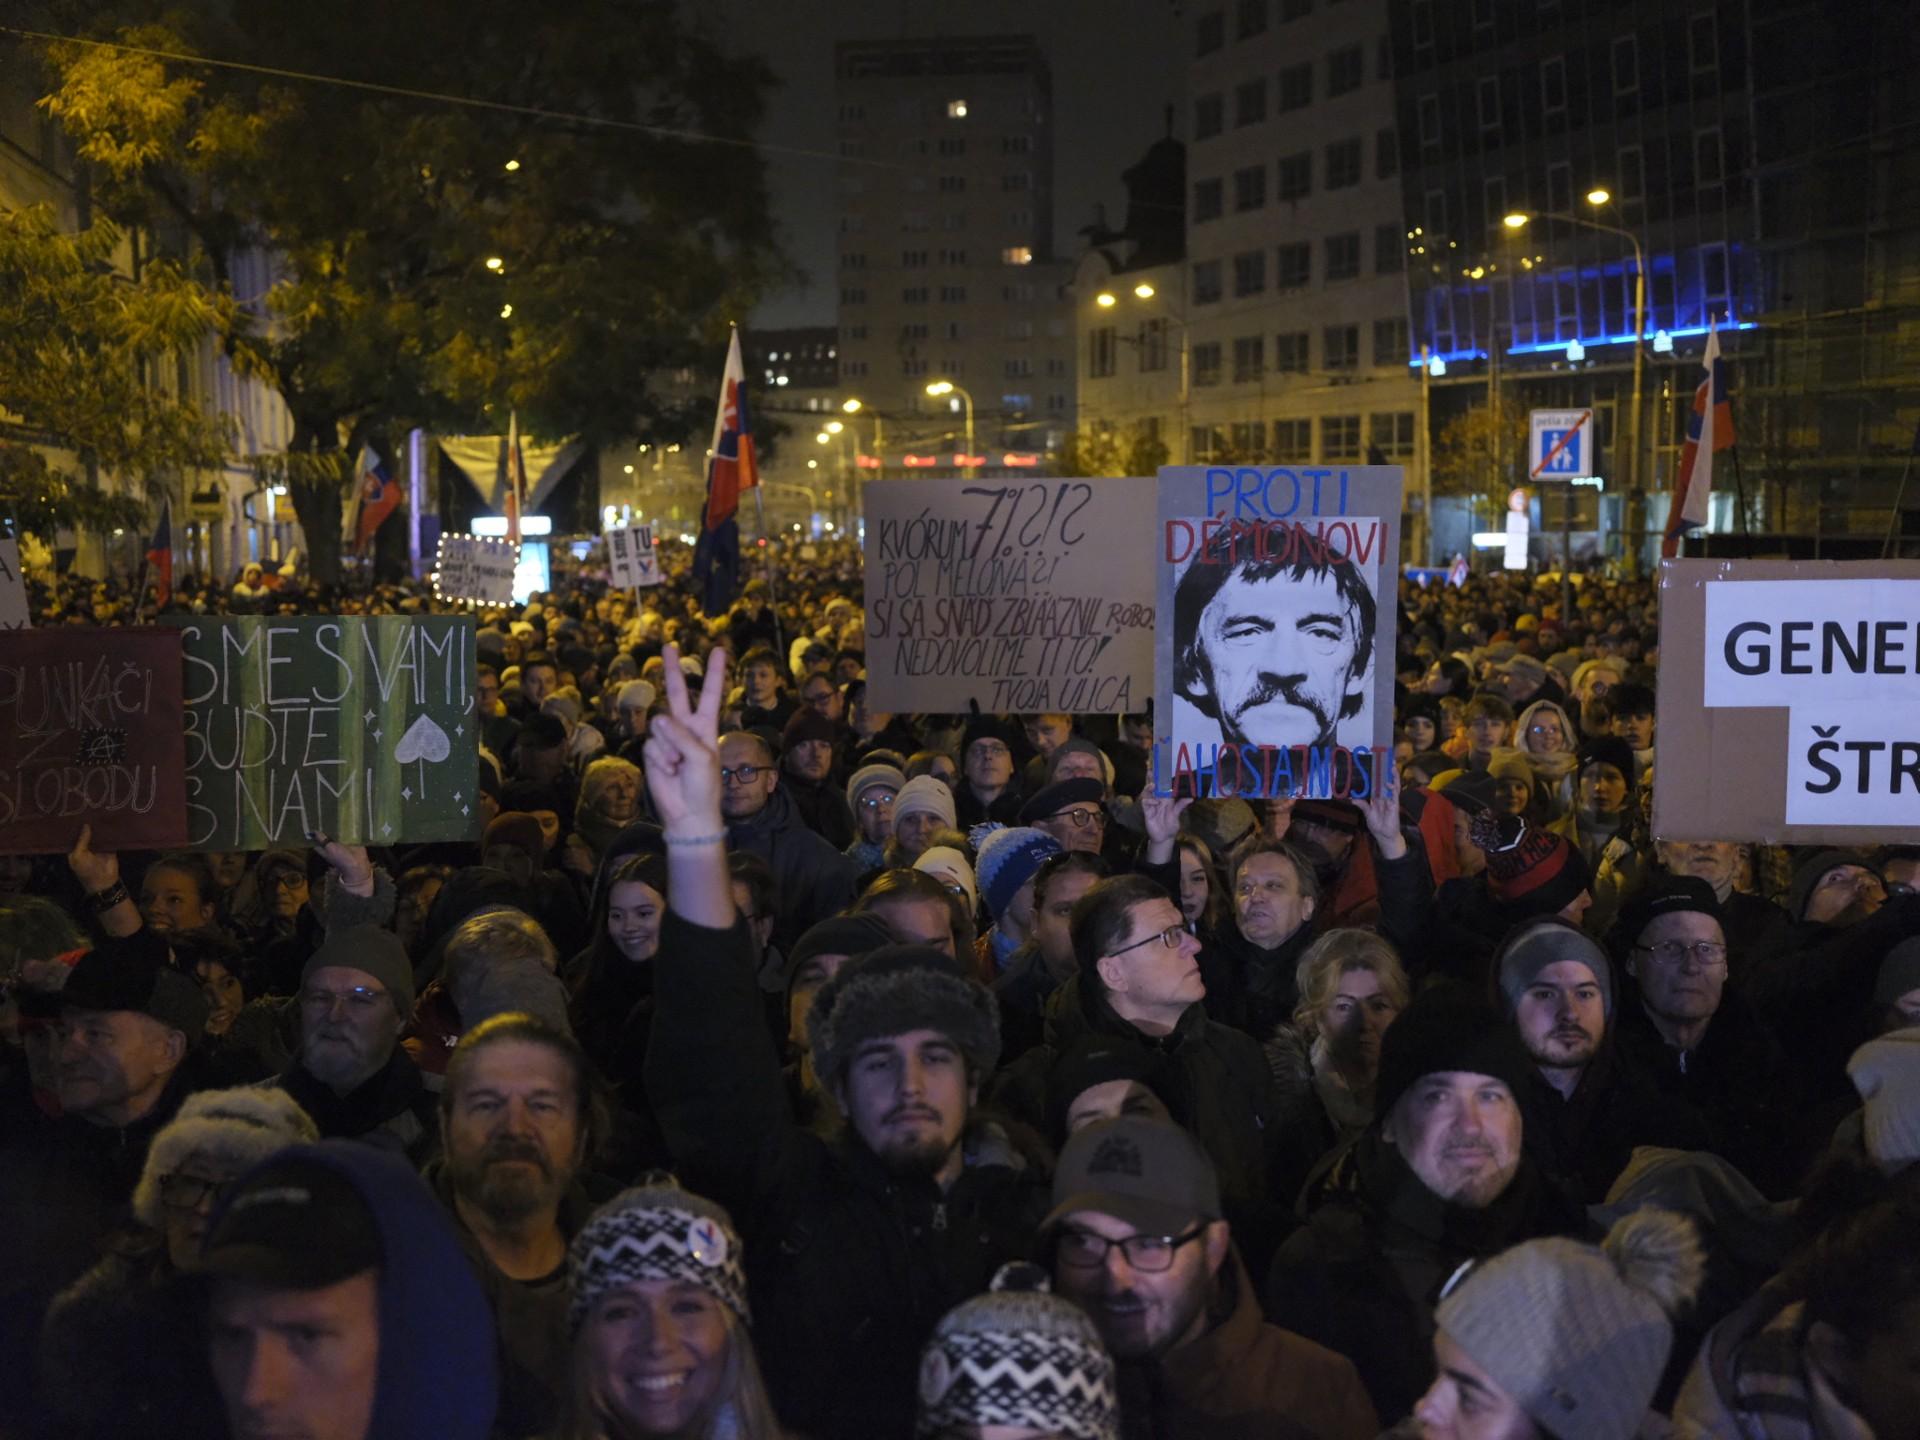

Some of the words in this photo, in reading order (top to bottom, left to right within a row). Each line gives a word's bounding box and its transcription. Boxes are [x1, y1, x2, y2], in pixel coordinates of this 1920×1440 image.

[1206, 469, 1349, 518] PROTI
[632, 526, 652, 551] TU
[879, 507, 968, 561] KVÓRUM
[1165, 510, 1388, 566] DÉMONOVI
[869, 598, 893, 639] SI
[897, 598, 925, 638] SA
[181, 624, 310, 705] SME
[312, 624, 353, 703] S
[361, 623, 475, 716] VAMI,
[1036, 637, 1064, 677] TI
[1064, 636, 1113, 676] TO!
[1723, 621, 1920, 676] GENE
[992, 678, 1050, 711] TVOJA
[1058, 675, 1131, 712] ULICA
[184, 703, 348, 771] BUĎTE
[234, 768, 373, 846] NAMI
